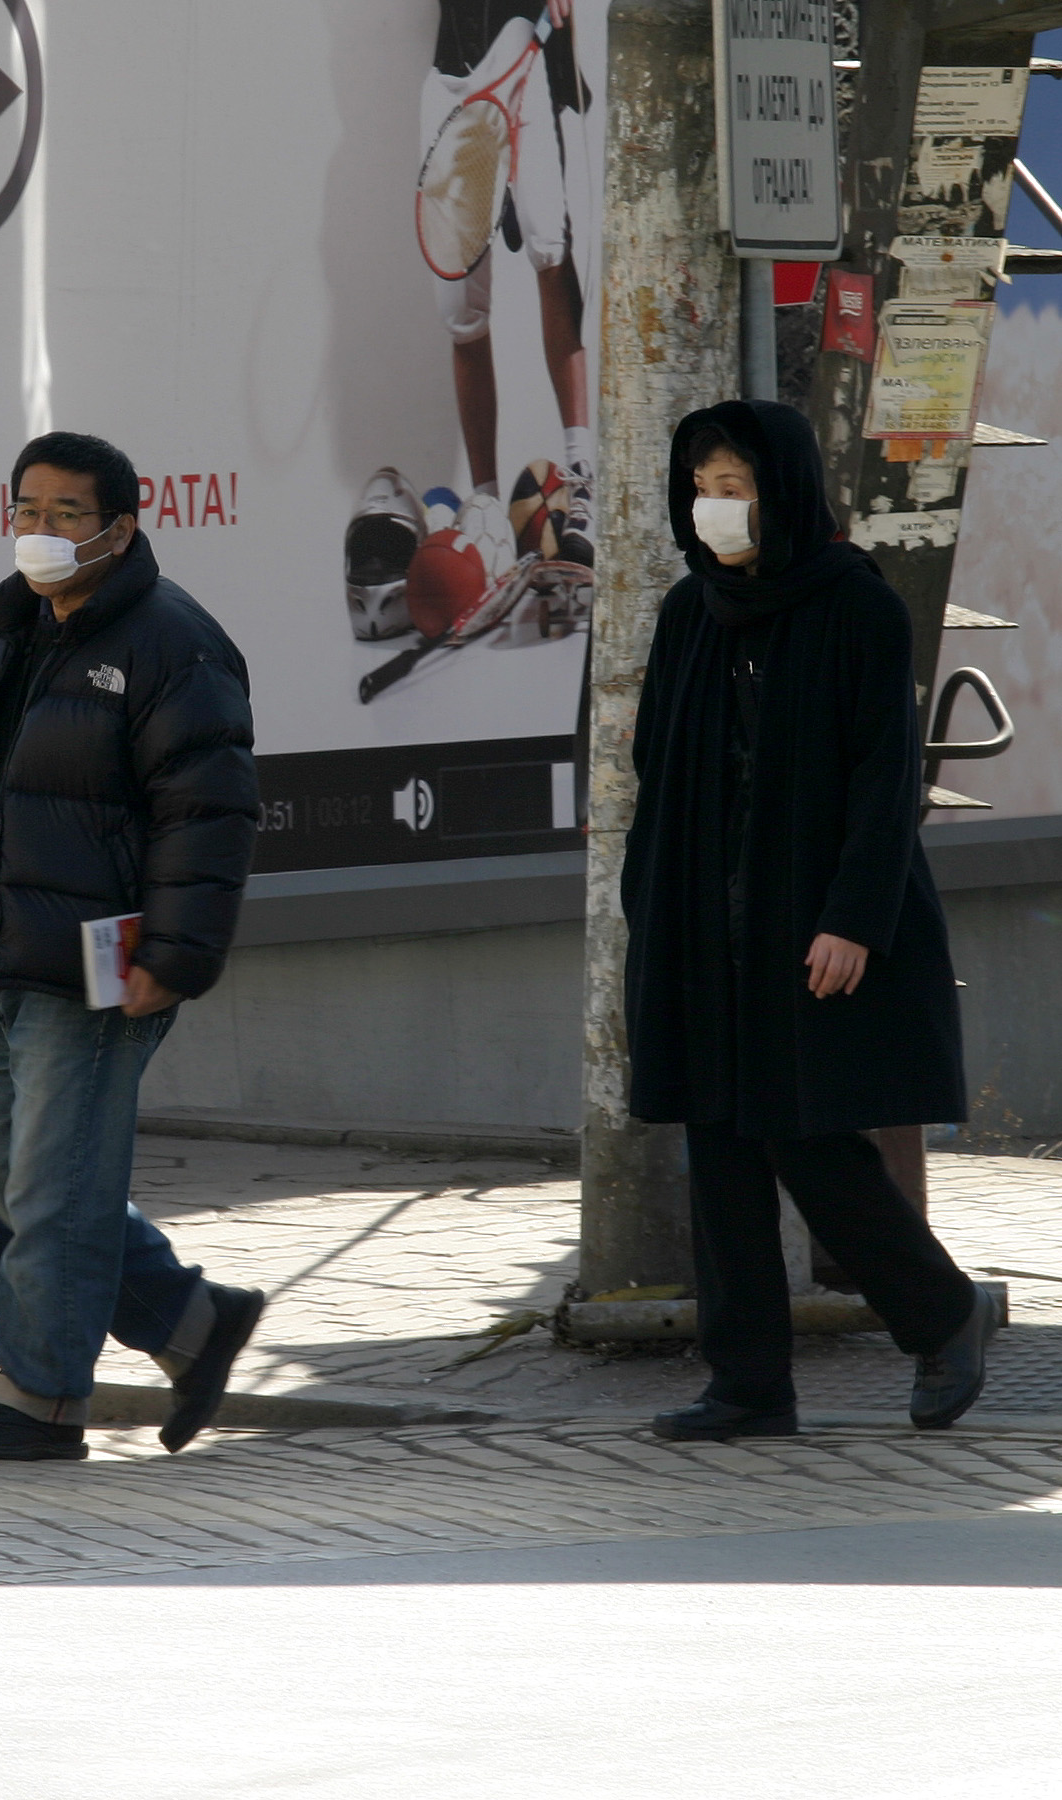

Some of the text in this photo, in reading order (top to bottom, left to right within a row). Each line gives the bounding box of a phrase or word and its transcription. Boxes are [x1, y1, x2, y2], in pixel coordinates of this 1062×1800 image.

[902, 237, 1000, 247] МАТЕМАТИКА
[138, 472, 237, 529] РАТА!
[256, 801, 293, 832] 0:51
